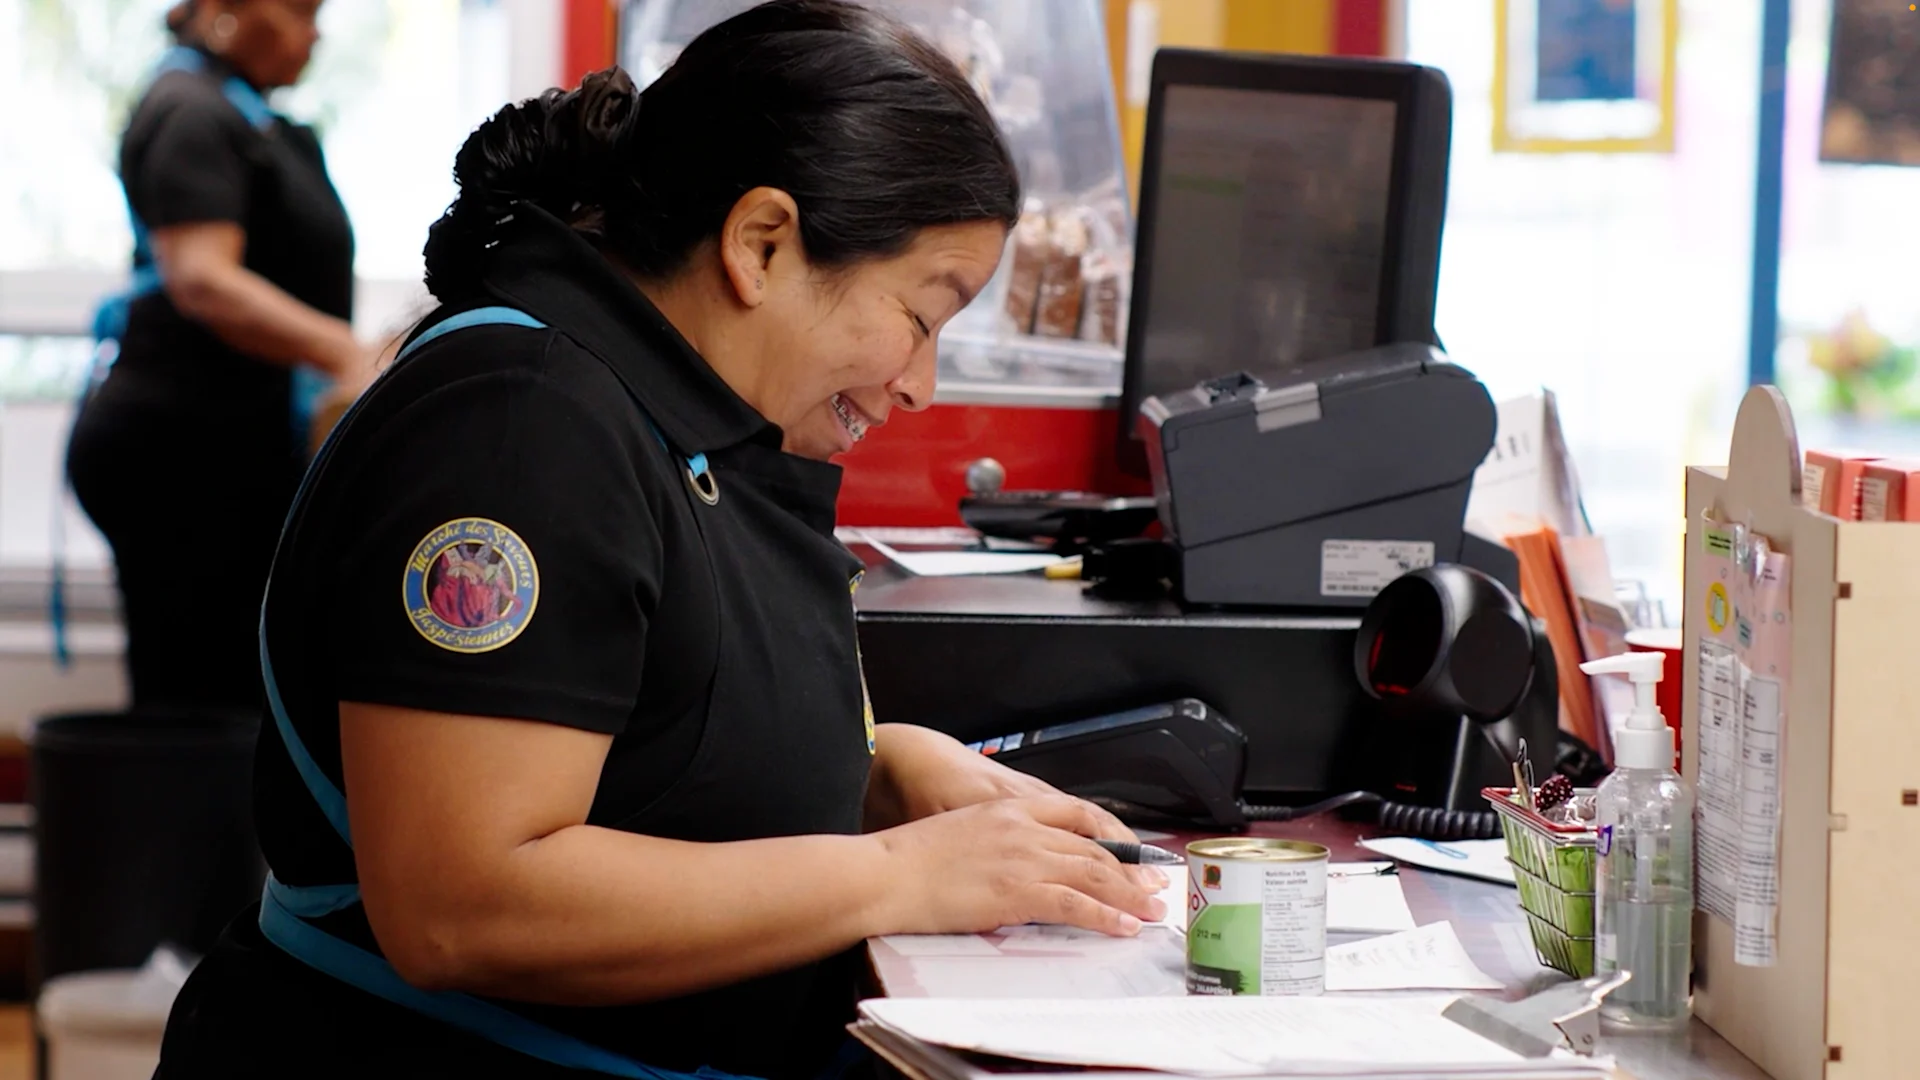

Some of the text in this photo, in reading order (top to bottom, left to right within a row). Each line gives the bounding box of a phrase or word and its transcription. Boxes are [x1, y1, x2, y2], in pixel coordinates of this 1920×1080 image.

[412, 522, 460, 573] Marché
[465, 521, 488, 536] des
[1196, 929, 1221, 940] 212 ml
